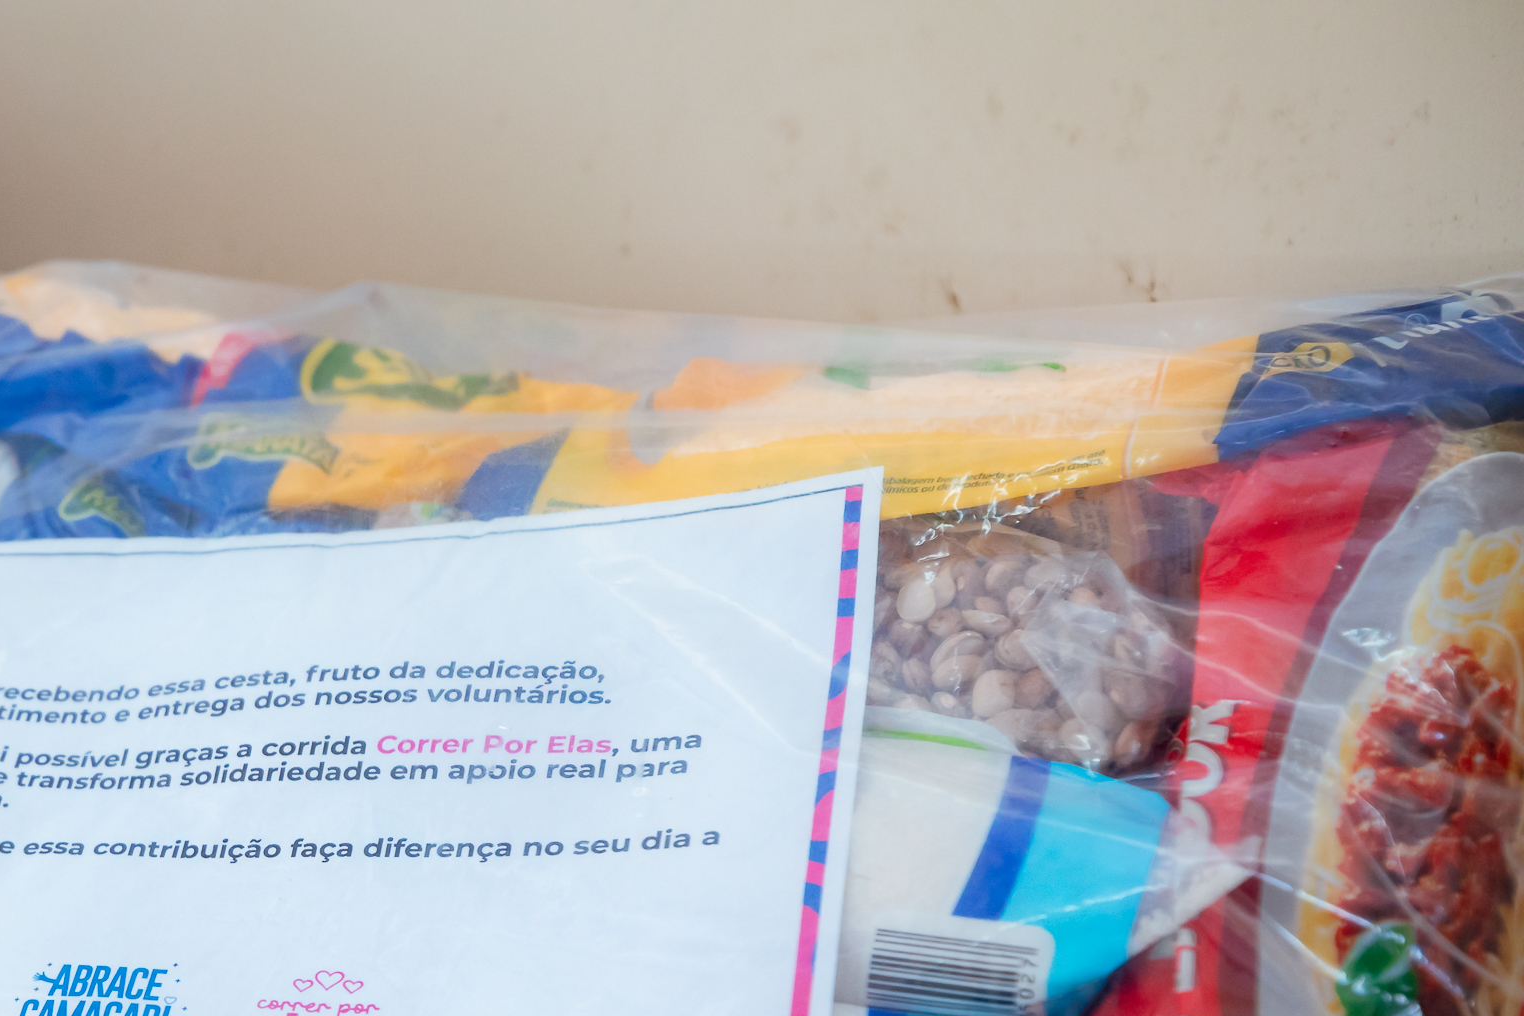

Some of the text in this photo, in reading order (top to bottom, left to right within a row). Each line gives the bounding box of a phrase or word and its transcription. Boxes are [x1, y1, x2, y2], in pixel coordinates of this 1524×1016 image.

[883, 476, 935, 487] mbalagem
[883, 484, 918, 494] ímicos
[147, 678, 206, 699] essa
[214, 669, 297, 691] cesta,
[305, 664, 381, 684] fruto
[389, 661, 427, 680] da
[436, 659, 606, 686] dedicação,
[114, 708, 131, 723] e
[138, 698, 245, 718] entrega
[254, 690, 307, 710] dos
[315, 684, 419, 706] nossos
[427, 683, 613, 705] voluntários.
[14, 748, 129, 769] possível
[135, 743, 229, 769] graças
[236, 743, 253, 759] a
[261, 734, 368, 758] corrida
[376, 734, 474, 755] Correr
[483, 735, 538, 755] Por
[546, 734, 620, 757] Elas,
[630, 734, 703, 753] uma
[16, 771, 173, 791] transforma
[178, 760, 382, 787] solidariedade
[389, 763, 440, 781] em
[447, 758, 538, 785] apoio
[546, 758, 607, 780] real
[614, 759, 689, 784] para
[23, 840, 86, 857] essa
[92, 838, 282, 864] contribuição
[289, 837, 354, 863] faça
[363, 836, 513, 864] diferença
[522, 840, 565, 858] no
[572, 836, 632, 856] seu
[640, 828, 692, 852] dia
[701, 829, 722, 847] a
[47, 964, 169, 1001] ABRACE
[256, 998, 333, 1014] correr
